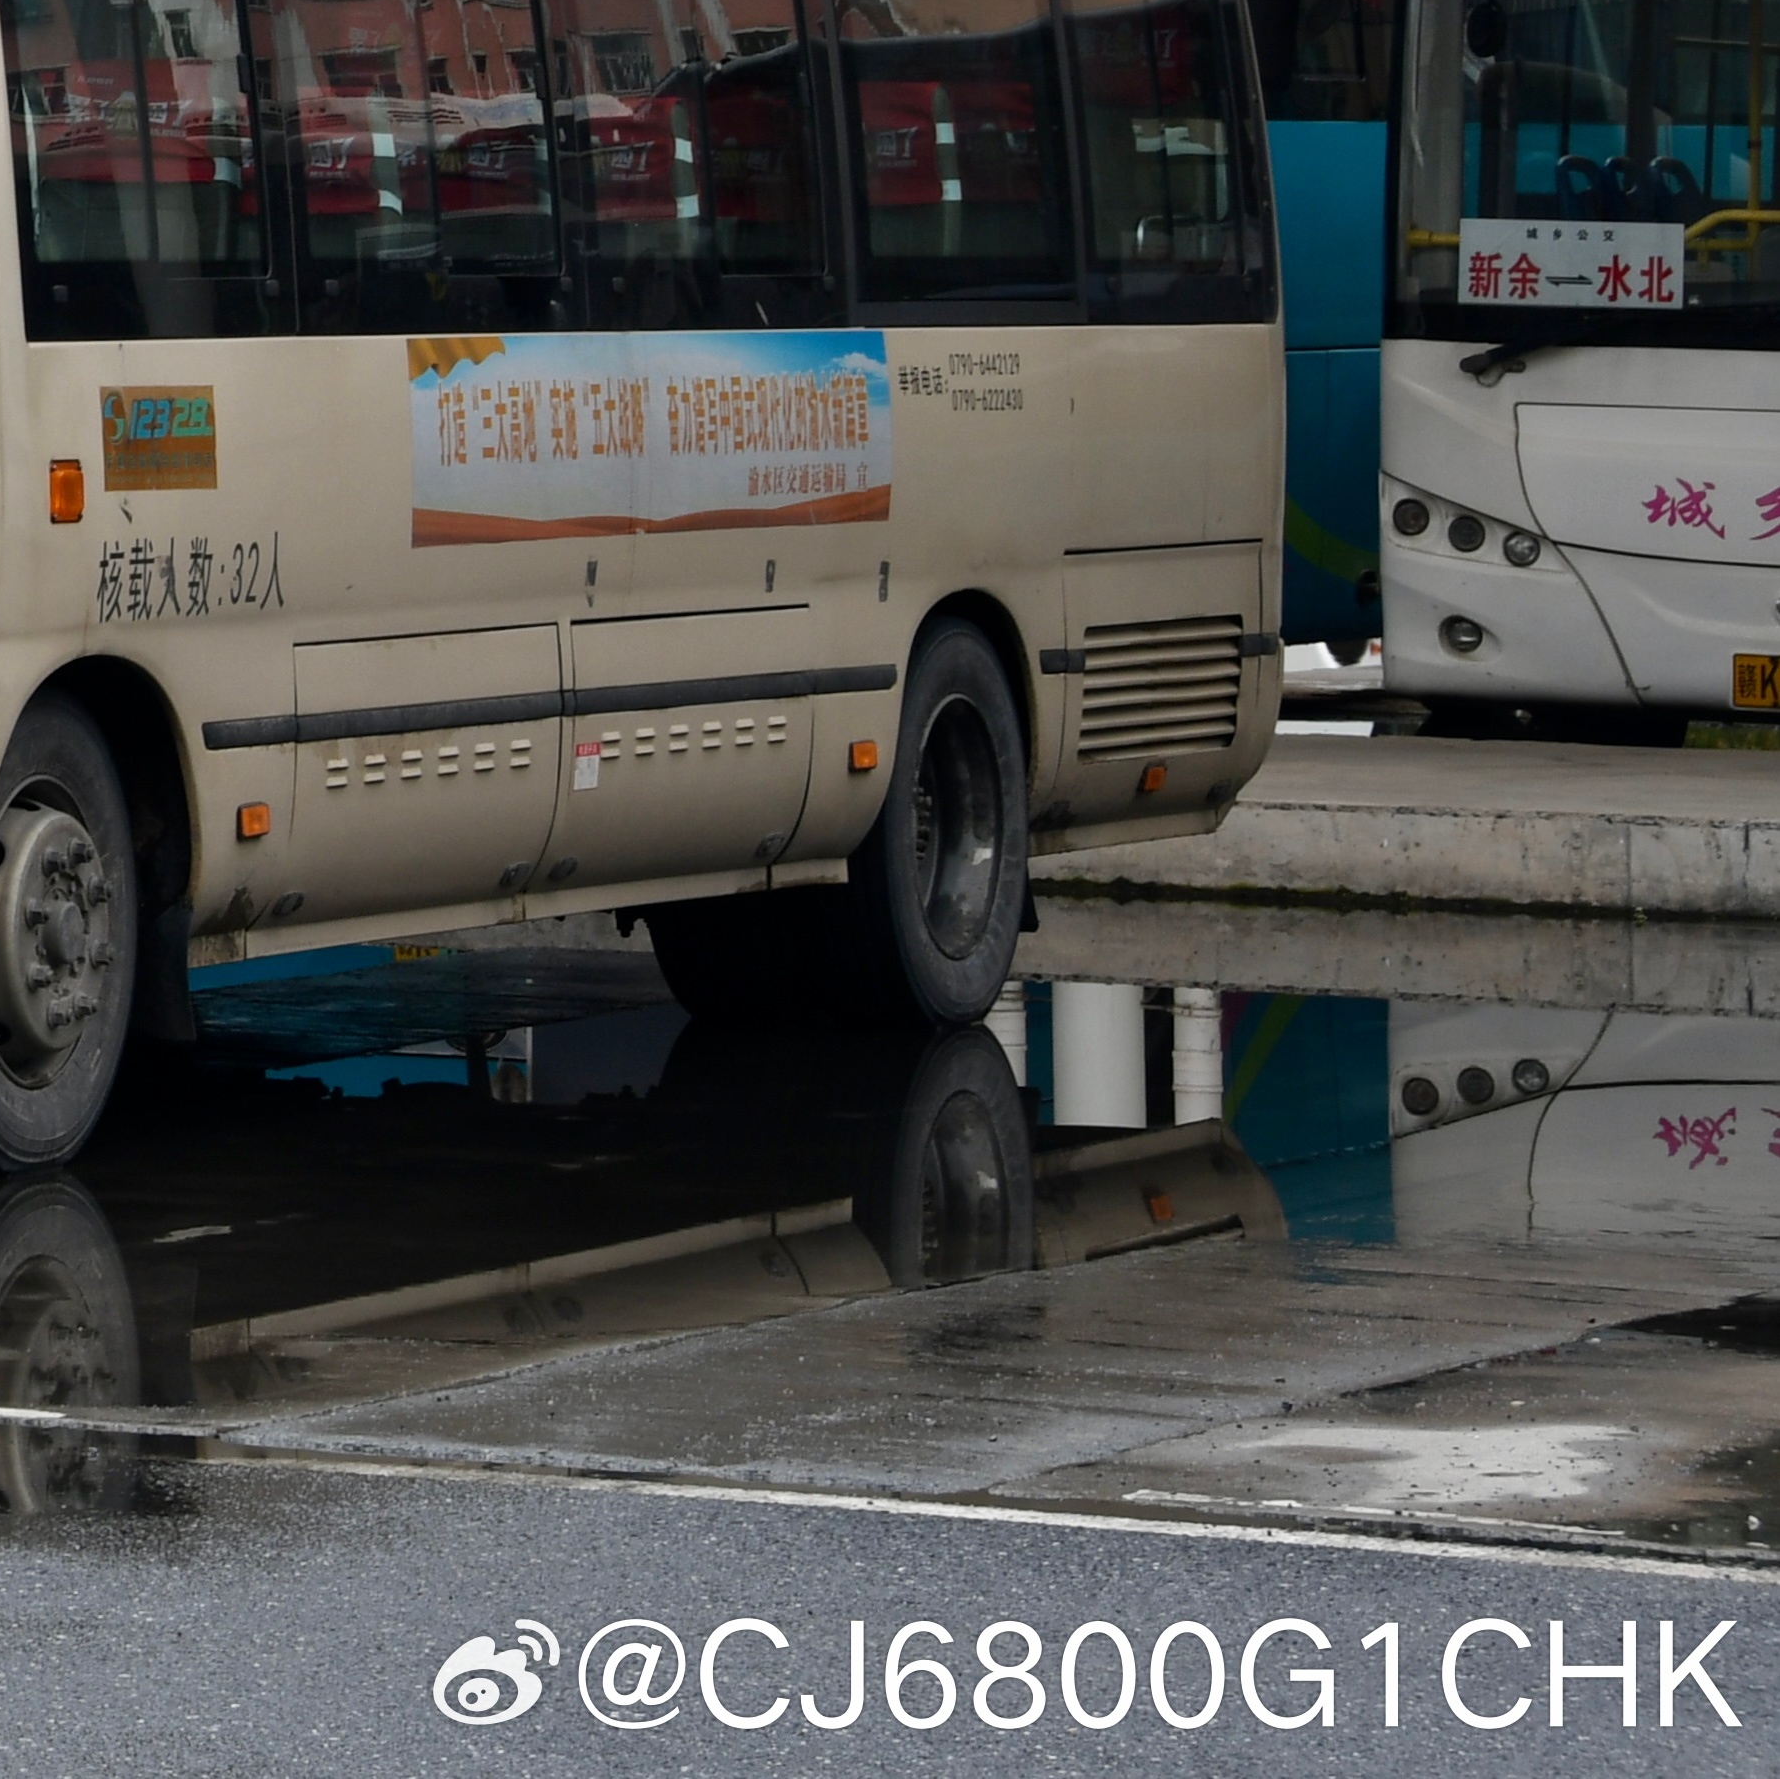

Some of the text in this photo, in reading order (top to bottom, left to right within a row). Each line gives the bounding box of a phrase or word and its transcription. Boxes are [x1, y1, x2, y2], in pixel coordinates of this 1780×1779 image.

[1526, 227, 1616, 242] 城乡公交
[1468, 251, 1676, 303] 新余 水北
[129, 397, 214, 439] 12328
